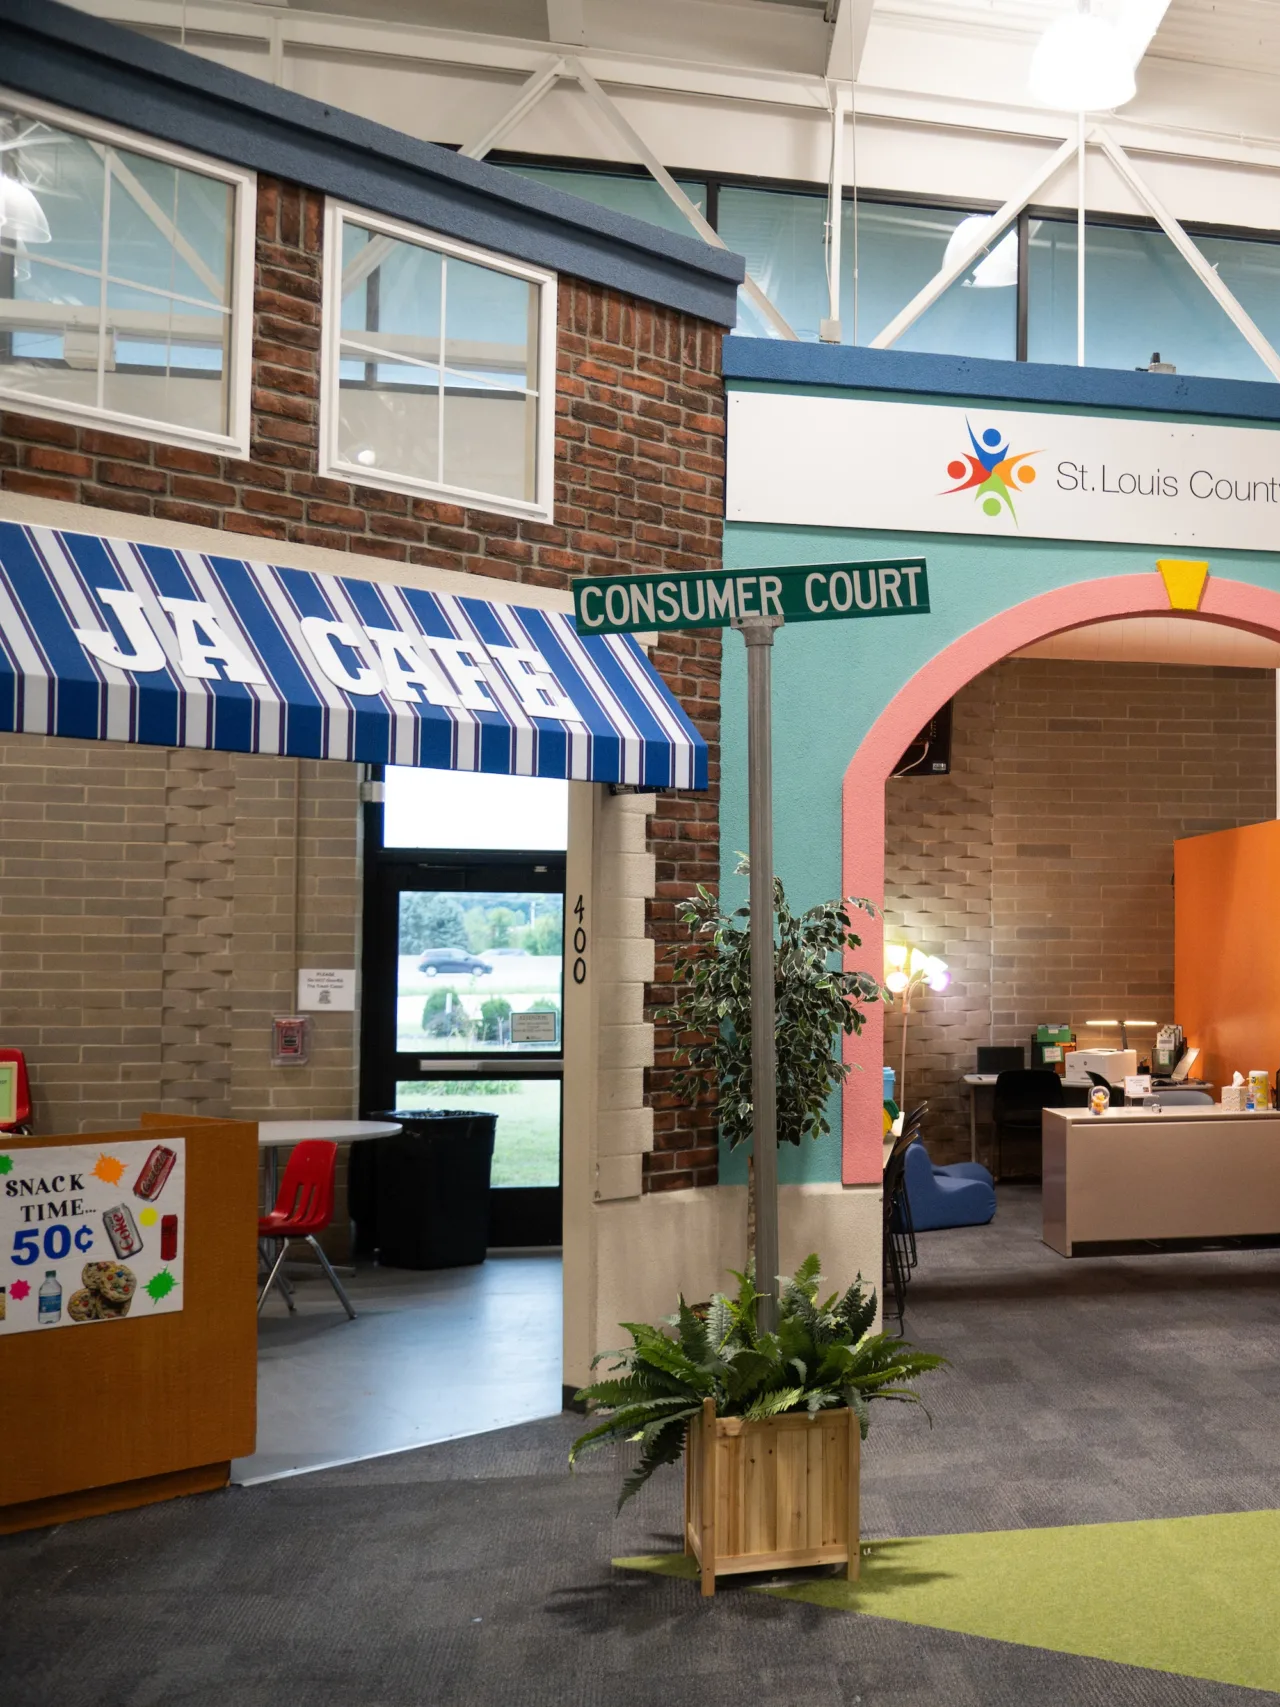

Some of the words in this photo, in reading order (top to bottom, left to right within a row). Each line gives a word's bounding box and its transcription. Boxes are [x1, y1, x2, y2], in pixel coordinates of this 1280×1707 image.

[1056, 460, 1096, 492] St.
[1101, 464, 1179, 498] Louis
[579, 574, 784, 628] CONSUMER
[804, 565, 923, 614] COURT
[73, 586, 268, 686] JA
[300, 616, 584, 723] CAFE
[573, 894, 587, 986] 400
[5, 1173, 85, 1198] SNACK
[20, 1198, 97, 1223] TIME...
[10, 1224, 94, 1266] 50¢
